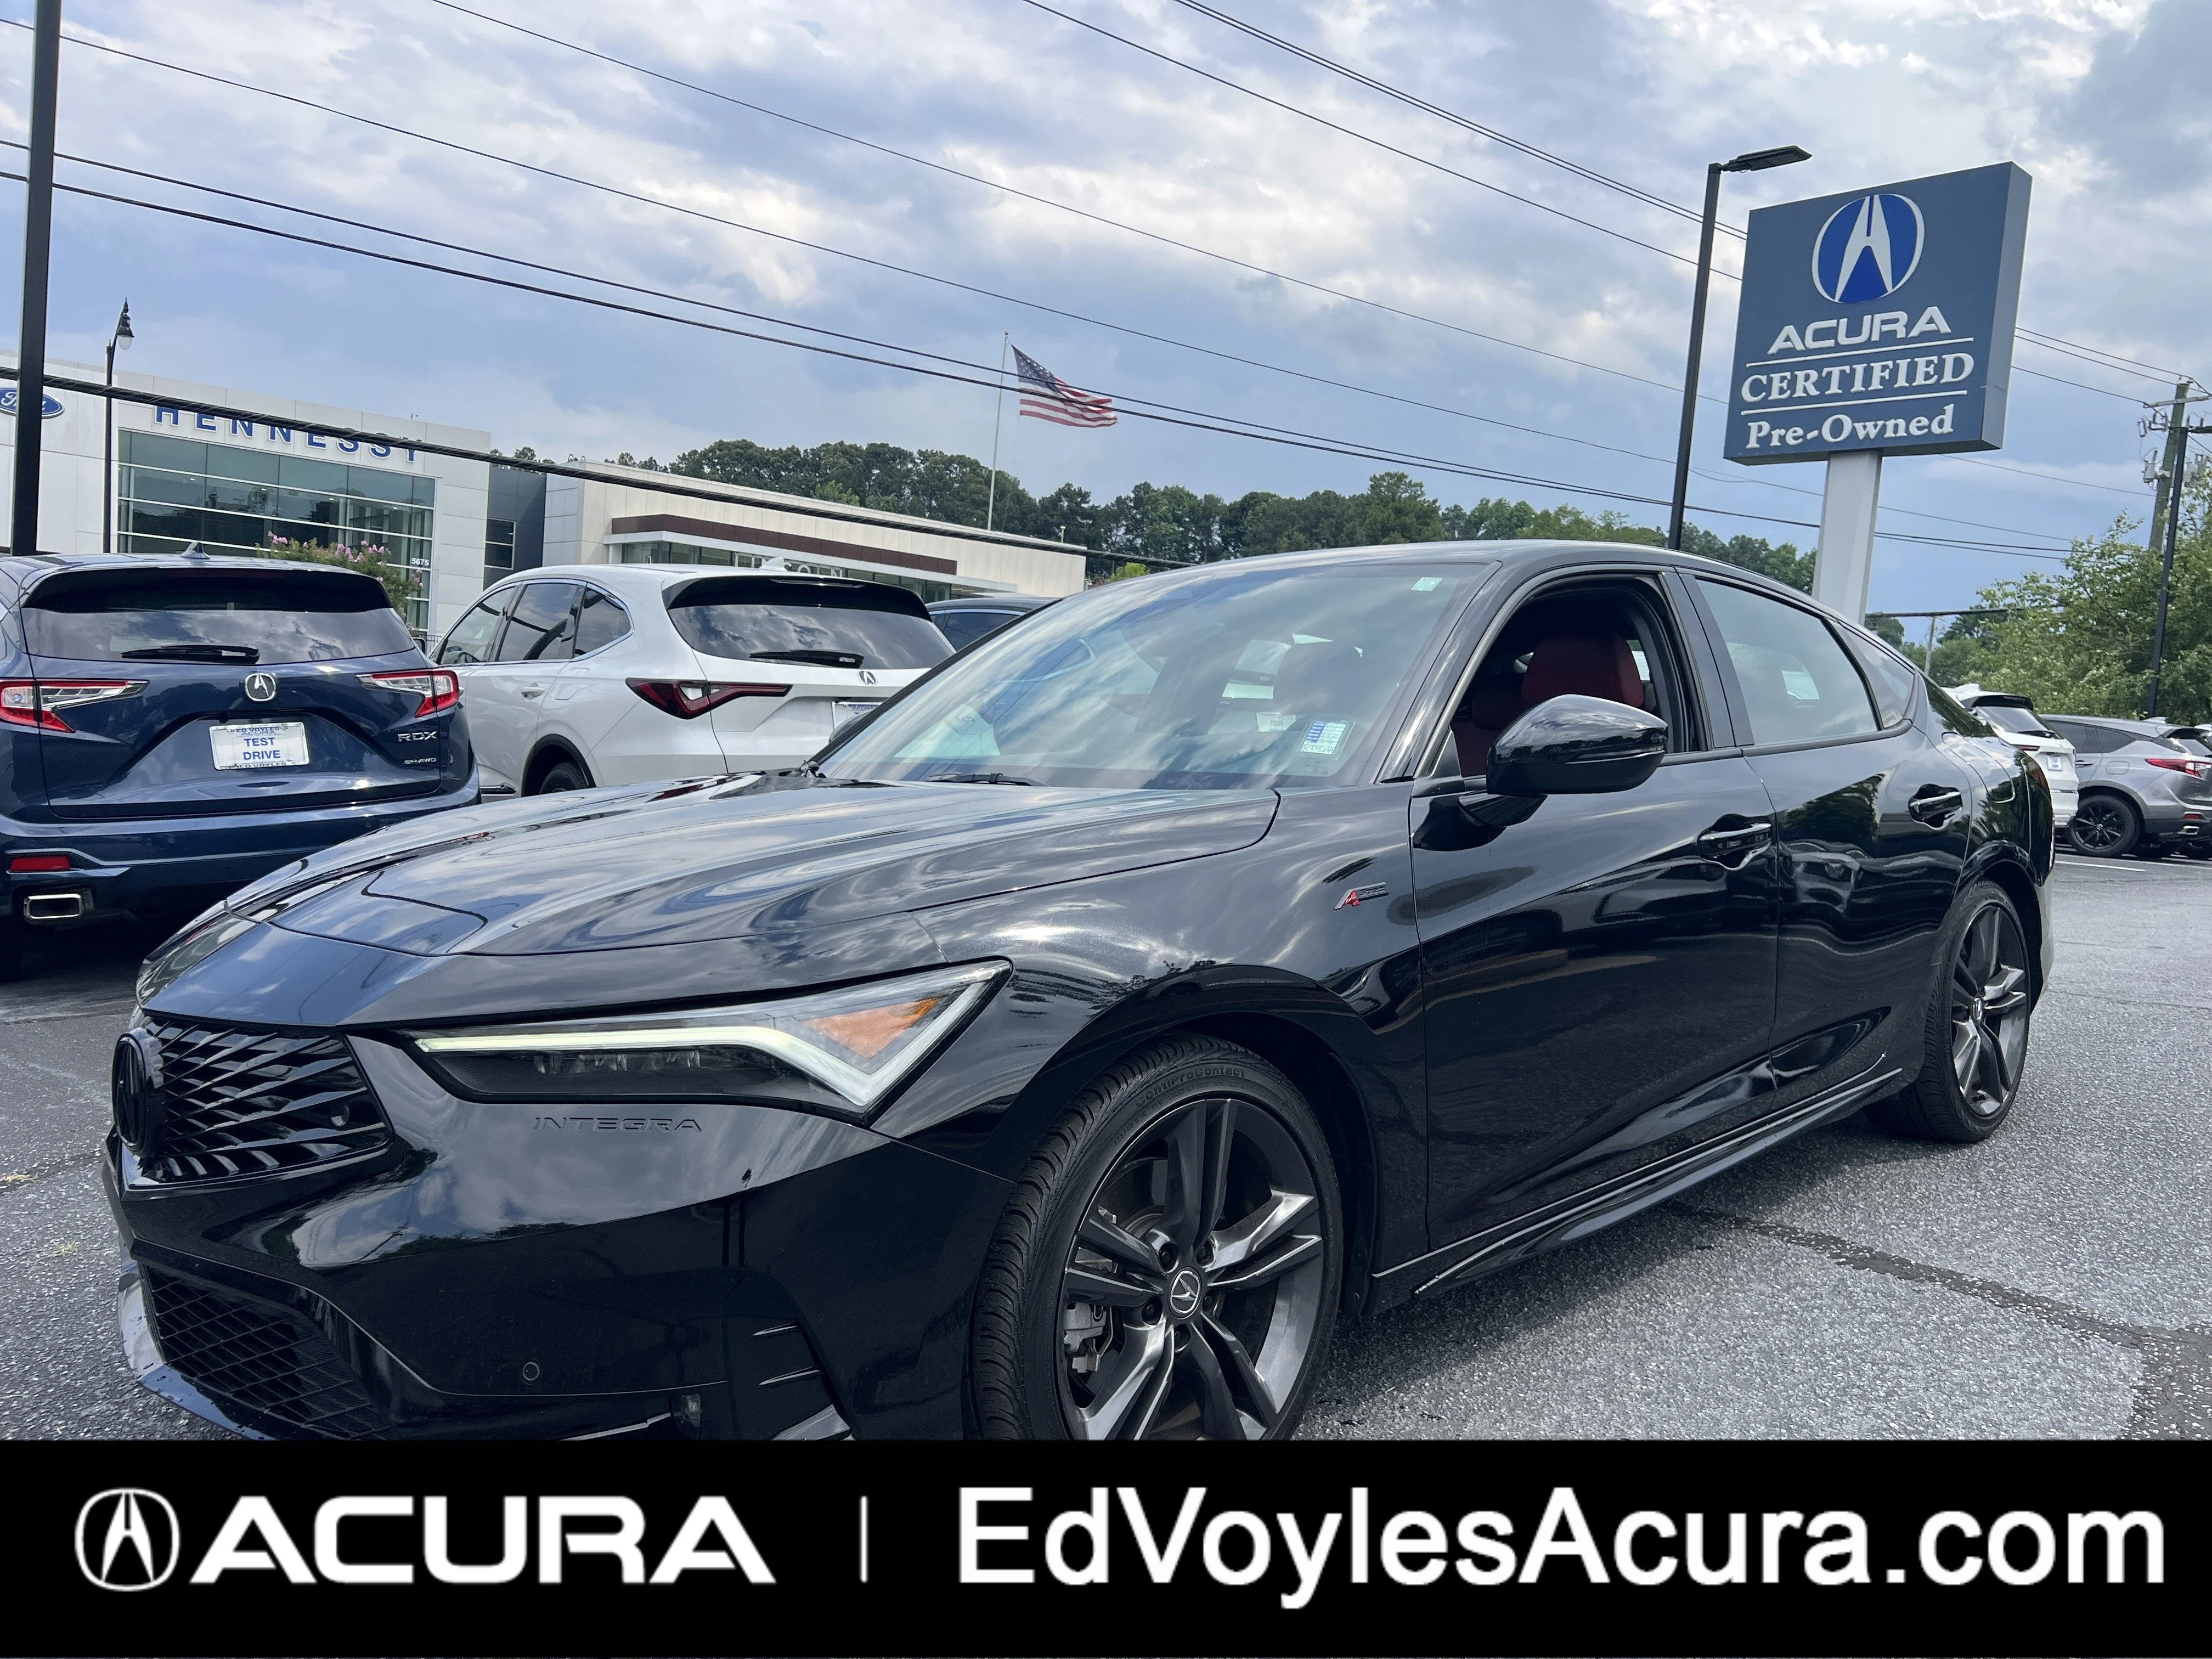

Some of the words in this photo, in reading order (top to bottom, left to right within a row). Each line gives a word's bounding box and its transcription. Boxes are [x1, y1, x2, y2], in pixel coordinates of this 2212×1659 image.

[1768, 306, 1952, 355] ACURA
[1741, 353, 1975, 403] CERTIFIED
[1745, 403, 1955, 449] Pre-Owned
[411, 557, 430, 566] 5675
[243, 737, 275, 747] TEST
[397, 730, 438, 742] RDX
[242, 749, 281, 760] DRIVE
[1134, 1065, 1246, 1108] ContiProContact
[532, 1117, 702, 1133] INTEGRA
